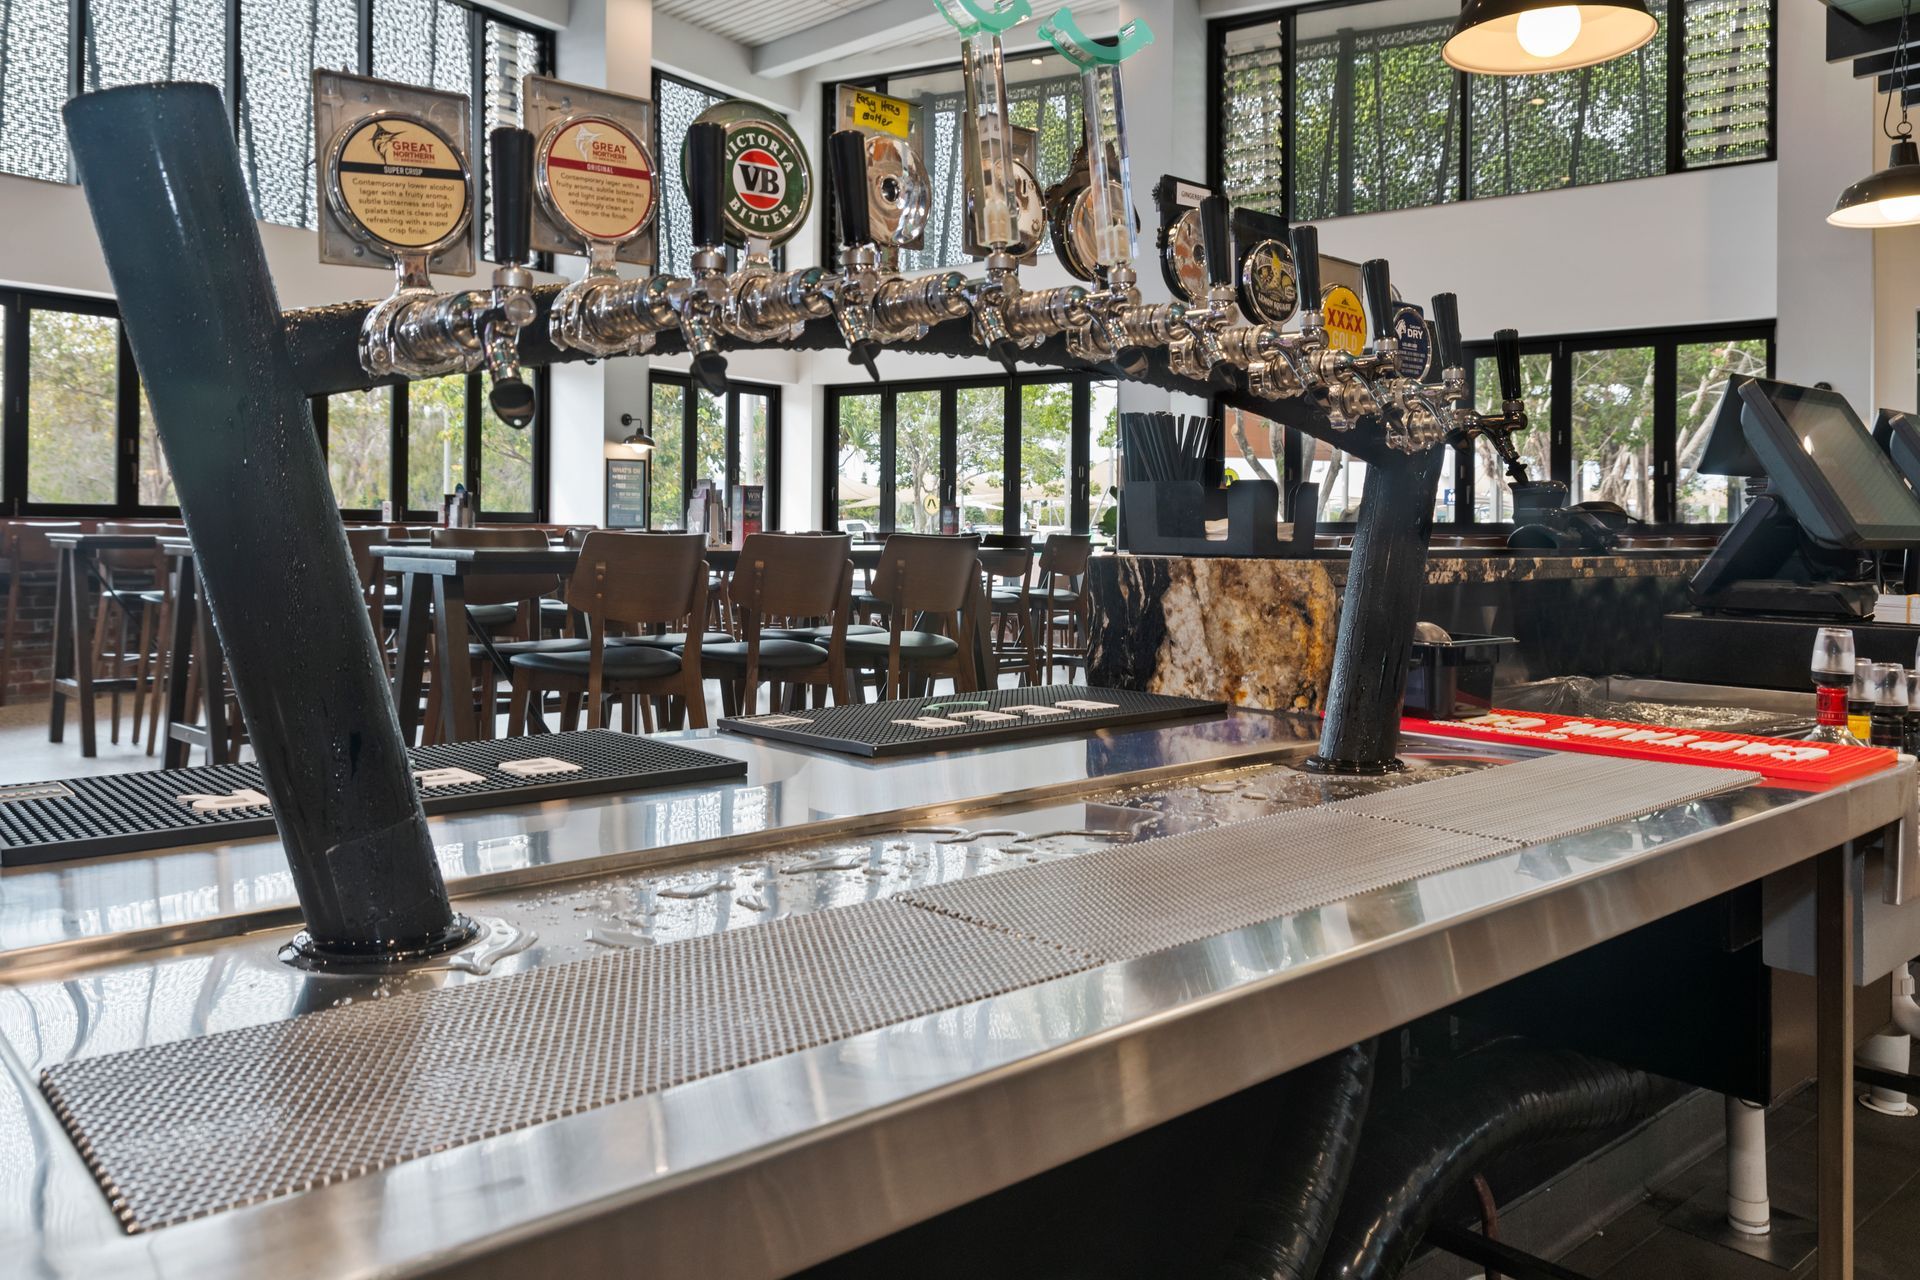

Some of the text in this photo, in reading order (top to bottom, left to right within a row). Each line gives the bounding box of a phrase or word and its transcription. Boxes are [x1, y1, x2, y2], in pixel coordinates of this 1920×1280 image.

[392, 141, 434, 152] GREAT
[592, 142, 626, 154] GREAT
[393, 151, 435, 160] NORTHERN
[592, 151, 627, 160] NORTHERN
[725, 133, 793, 173] VICTORIA
[384, 166, 423, 176] SUPER CRISP
[586, 163, 614, 174] ORIGINAL
[352, 178, 406, 188] Contemporary
[560, 172, 604, 185] Contemporary
[738, 164, 780, 194] VB
[360, 188, 378, 198] lager
[405, 190, 424, 199] fruity
[556, 180, 572, 188] fruity
[596, 186, 614, 194] subtle
[616, 188, 644, 198] bitterness
[581, 192, 594, 200] light
[384, 198, 419, 207] bitterness
[437, 202, 452, 210] light
[365, 207, 388, 215] palate
[390, 208, 404, 216] that
[600, 210, 610, 218] the
[728, 197, 792, 226] BITTER
[366, 217, 403, 226] refreshing
[389, 226, 406, 234] crisp
[1328, 308, 1362, 334] XXXX
[1408, 328, 1423, 340] DRY
[1332, 330, 1358, 352] GOLD
